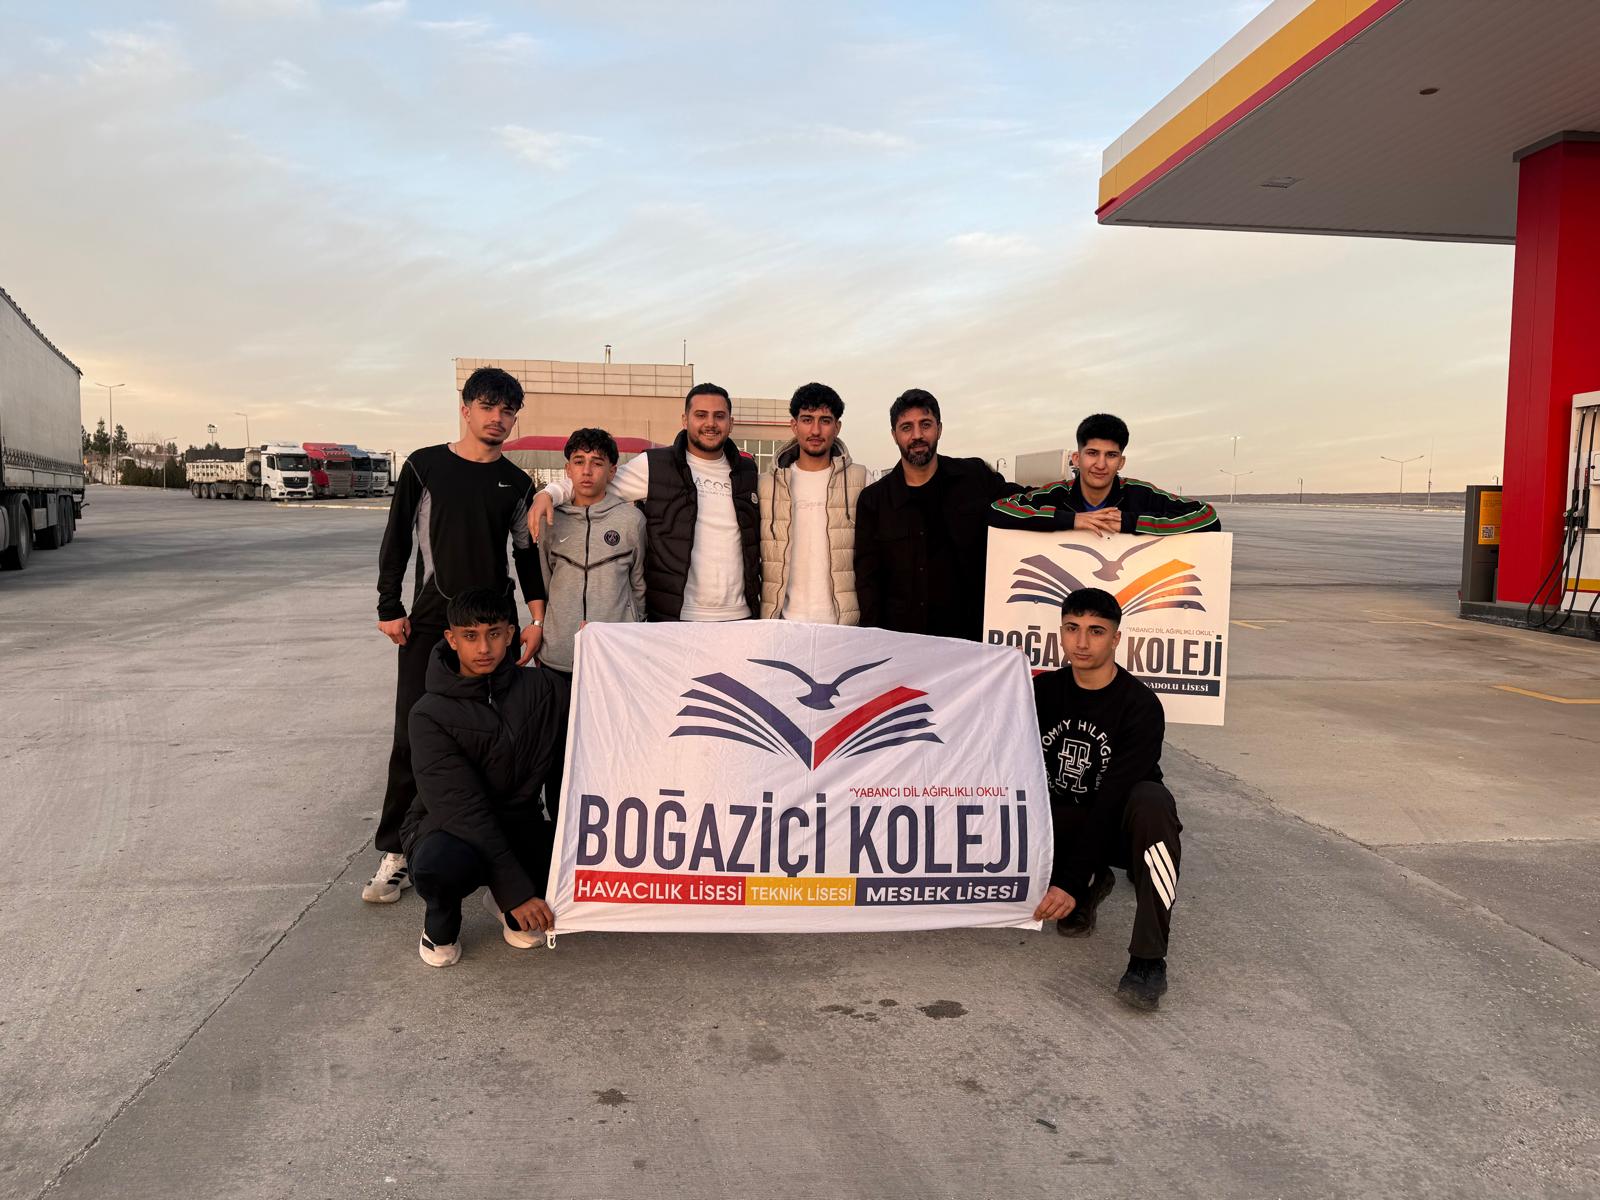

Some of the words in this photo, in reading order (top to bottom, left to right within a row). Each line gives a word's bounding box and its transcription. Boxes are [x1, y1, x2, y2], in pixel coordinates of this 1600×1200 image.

[1126, 634, 1222, 677] KOLEJİ
[1143, 681, 1179, 691] NADOLU
[1181, 682, 1209, 692] LİSESİ
[849, 787, 900, 797] "YABANCI
[903, 785, 920, 797] DİL
[922, 785, 973, 797] AĞIRLIKLI
[976, 786, 1009, 797] OKUL"
[576, 788, 826, 878] BOĞAZİÇİ
[850, 790, 1028, 874] KOLEJİ
[577, 879, 683, 900] HAVACILIK
[689, 880, 742, 901] LİSESİ
[751, 883, 804, 901] TEKNİK
[807, 884, 852, 901] LİSESİ
[866, 886, 951, 902] MESLEK
[956, 881, 1018, 900] LİSESİ
